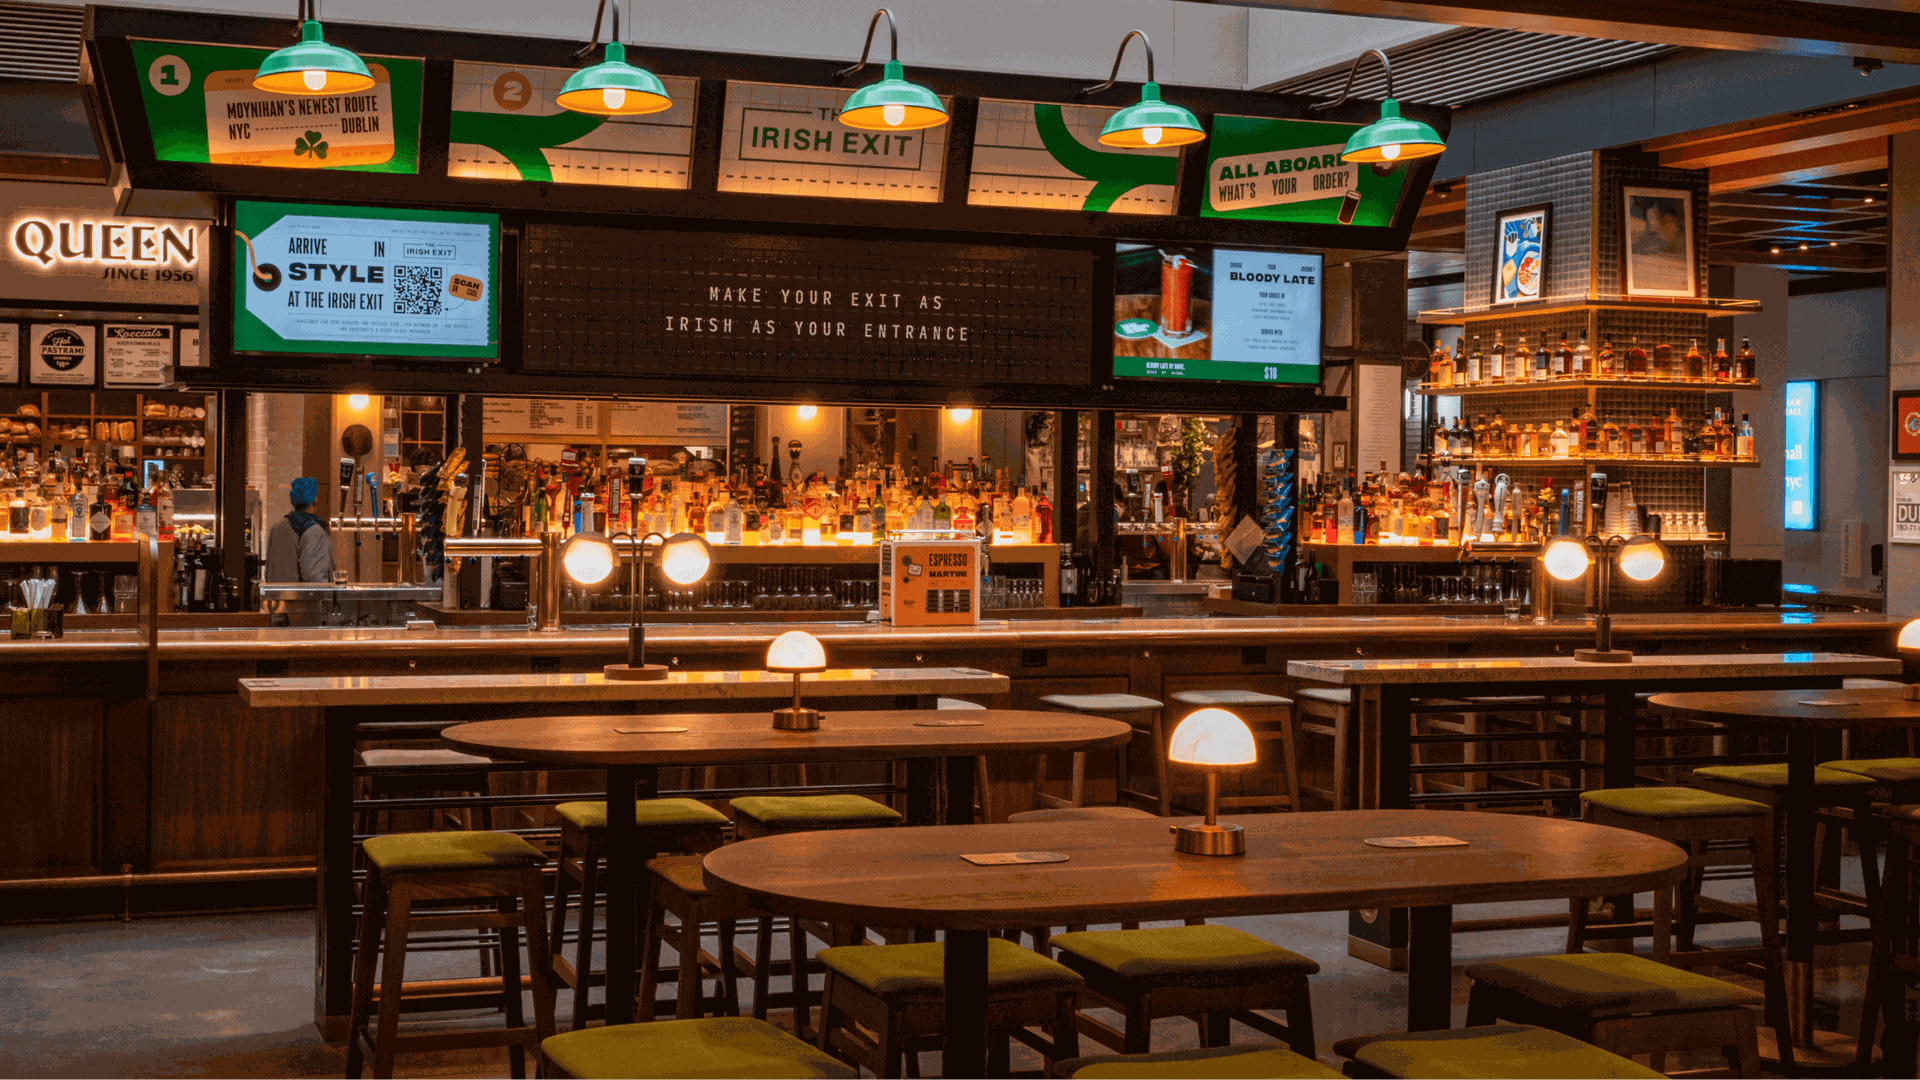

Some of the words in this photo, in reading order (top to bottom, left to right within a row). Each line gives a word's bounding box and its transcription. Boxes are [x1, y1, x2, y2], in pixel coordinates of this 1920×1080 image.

[160, 64, 179, 86] 1
[503, 81, 523, 101] 2
[226, 99, 296, 119] MOYNIHAN'S
[298, 97, 341, 116] NEWEST
[344, 95, 378, 113] ROUTE
[818, 107, 842, 121] TH
[228, 123, 251, 140] NYC
[341, 116, 380, 134] DUBLIN
[751, 126, 832, 152] IRISH
[842, 131, 914, 158] EXIT
[1219, 163, 1259, 181] ALL
[1218, 182, 1256, 203] WHAT'S
[1272, 177, 1297, 196] YOUR
[1313, 170, 1350, 191] ORDER?
[14, 220, 196, 266] QUEEN
[288, 237, 327, 255] ARRIVE
[374, 240, 385, 257] IN
[406, 247, 431, 256] IRISH
[431, 248, 453, 257] EXIT
[102, 266, 149, 281] SINCE
[155, 268, 195, 282] 1956
[288, 261, 384, 284] STYLE
[1229, 271, 1280, 284] BLOODY
[1283, 274, 1316, 285] LATE
[453, 277, 480, 290] SCAN
[287, 290, 301, 308] AT
[305, 291, 324, 309] THE
[328, 292, 356, 310] IRISH
[360, 293, 384, 311] EXIT
[709, 286, 762, 304] MAKE
[781, 288, 833, 306] YOUR
[851, 291, 901, 309] EXIT
[919, 295, 943, 310] AS
[113, 328, 164, 339] Specials
[665, 315, 733, 334] IRISH
[752, 319, 776, 335] AS
[794, 320, 846, 337] YOUR
[864, 323, 969, 341] ENTRANCE
[41, 346, 85, 355] PASTRAMI
[51, 335, 73, 347] Hot
[1263, 366, 1278, 381] $18
[612, 478, 621, 515] WOLFHOUND
[1898, 504, 1920, 523] DU
[928, 553, 968, 567] ESPRESSO
[928, 570, 968, 578] MARTINI
